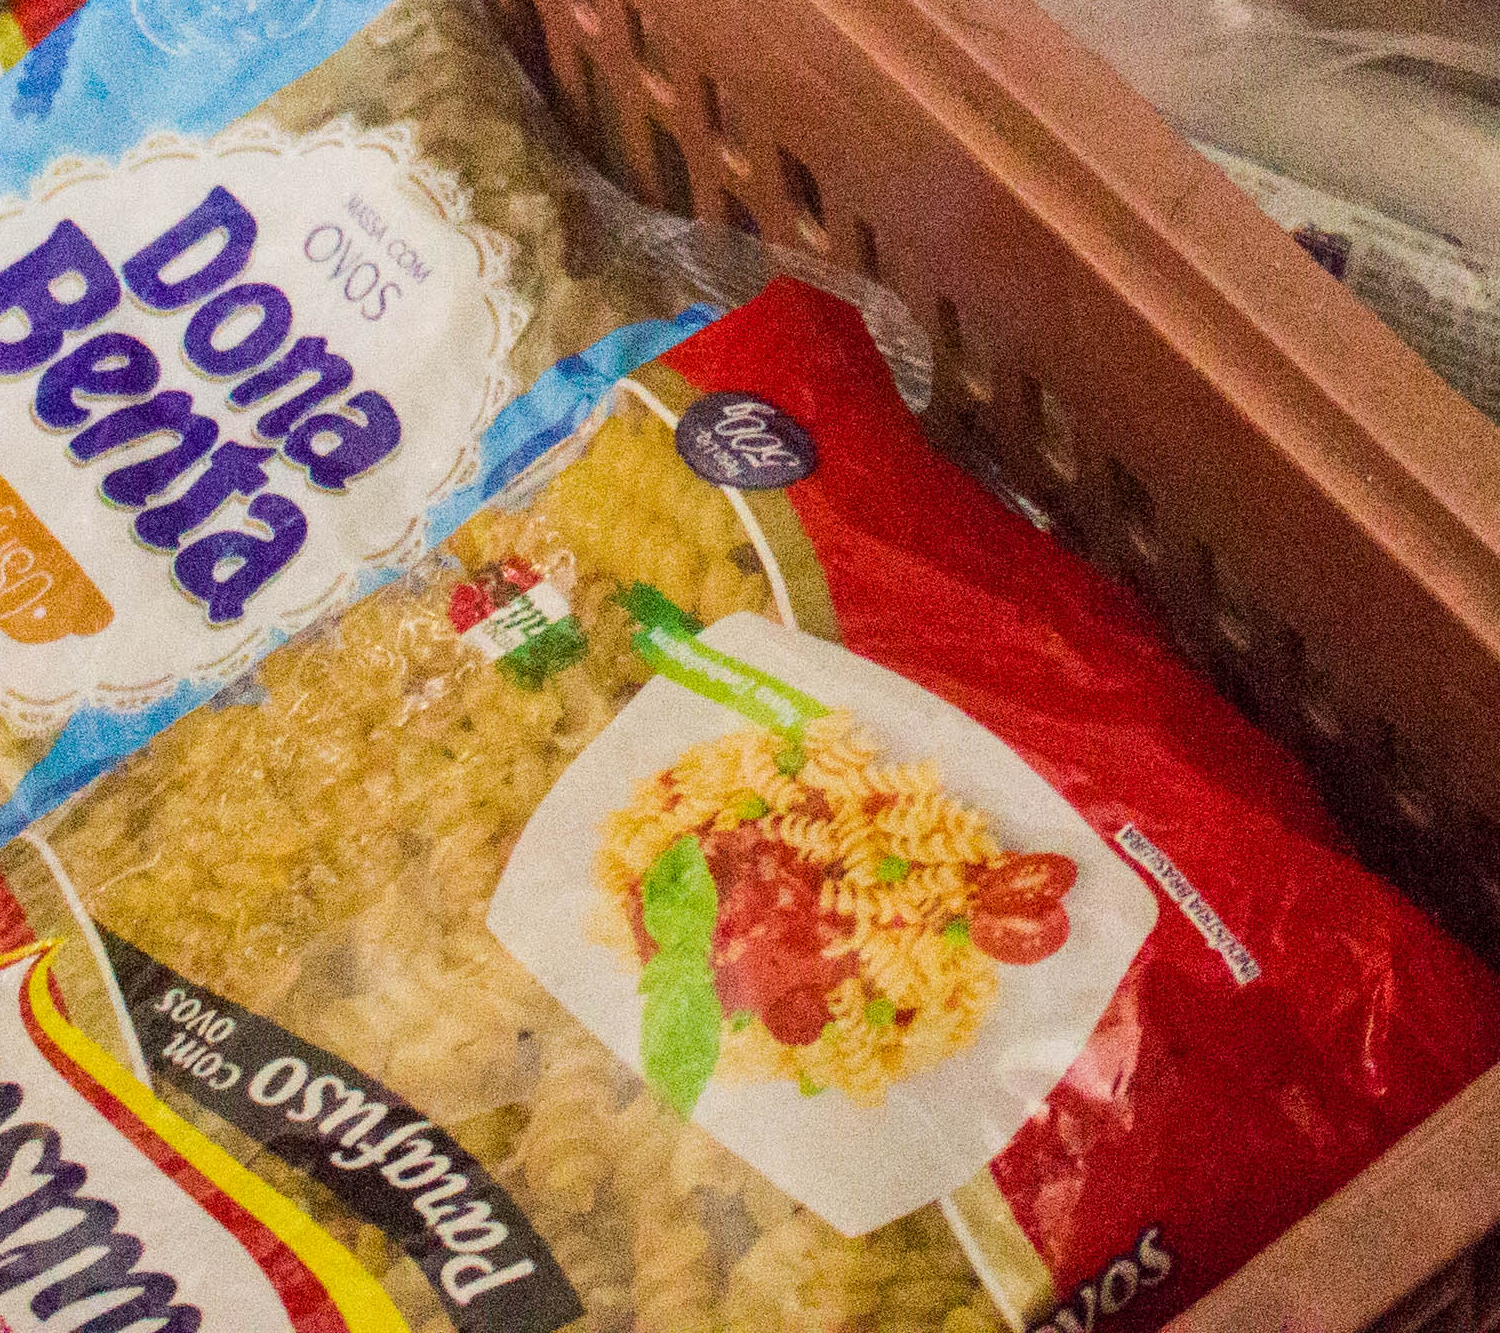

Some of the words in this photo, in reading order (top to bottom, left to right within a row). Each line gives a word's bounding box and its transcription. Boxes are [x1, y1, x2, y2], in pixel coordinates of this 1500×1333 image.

[304, 221, 405, 322] OVOS
[380, 231, 433, 290] COM
[120, 184, 403, 491] Dona
[710, 397, 800, 472] 500g
[153, 986, 238, 1045] ovos
[162, 1032, 243, 1091] com
[248, 1051, 538, 1307] Parafuso
